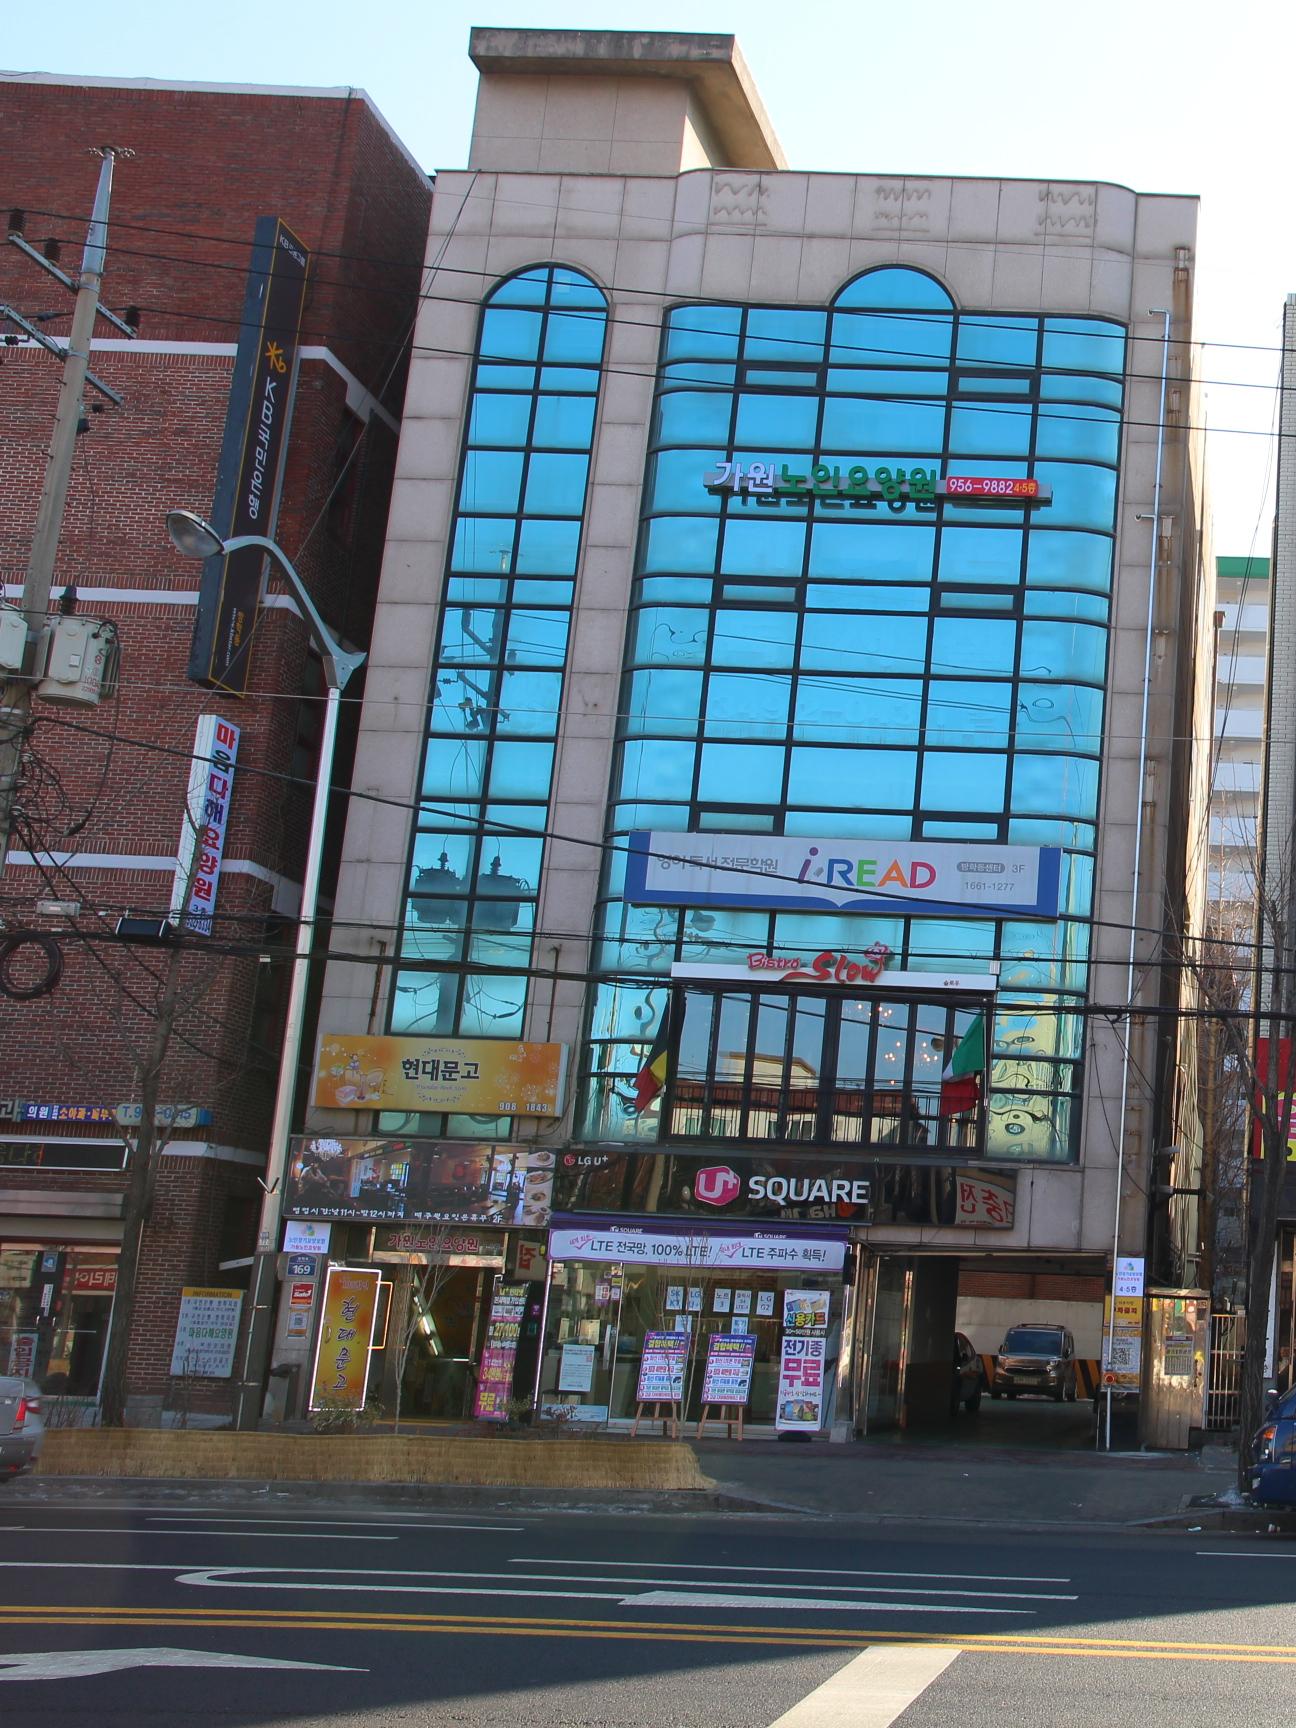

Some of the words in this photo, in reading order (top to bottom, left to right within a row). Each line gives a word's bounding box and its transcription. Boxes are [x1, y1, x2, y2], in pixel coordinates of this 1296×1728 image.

[249, 376, 277, 520] KB국민은행
[713, 462, 936, 501] 가원노인요양원
[949, 478, 1013, 494] 956-9882
[193, 722, 237, 903] 마음다해요양원
[827, 857, 937, 889] READ
[1011, 864, 1025, 874] 3F
[964, 881, 1015, 892] 1661-1277
[747, 952, 800, 971] Bistro
[781, 951, 888, 983] Slow
[402, 1058, 480, 1082] 현대문고
[27, 1105, 49, 1119] 의원
[578, 1156, 591, 1166] LG
[594, 1155, 609, 1166] U+
[748, 1176, 870, 1205] SQUARE
[388, 1234, 480, 1252] 가원노인요양원
[590, 1240, 613, 1253] LTE
[651, 1244, 683, 1257] 100%
[742, 1247, 765, 1260] LTE
[767, 1247, 799, 1262] 주파수
[801, 1249, 827, 1263] 획득!
[292, 1264, 311, 1275] 169
[785, 1311, 826, 1327] 신용카드
[784, 1339, 823, 1357] 전기종
[783, 1358, 821, 1388] 무료
